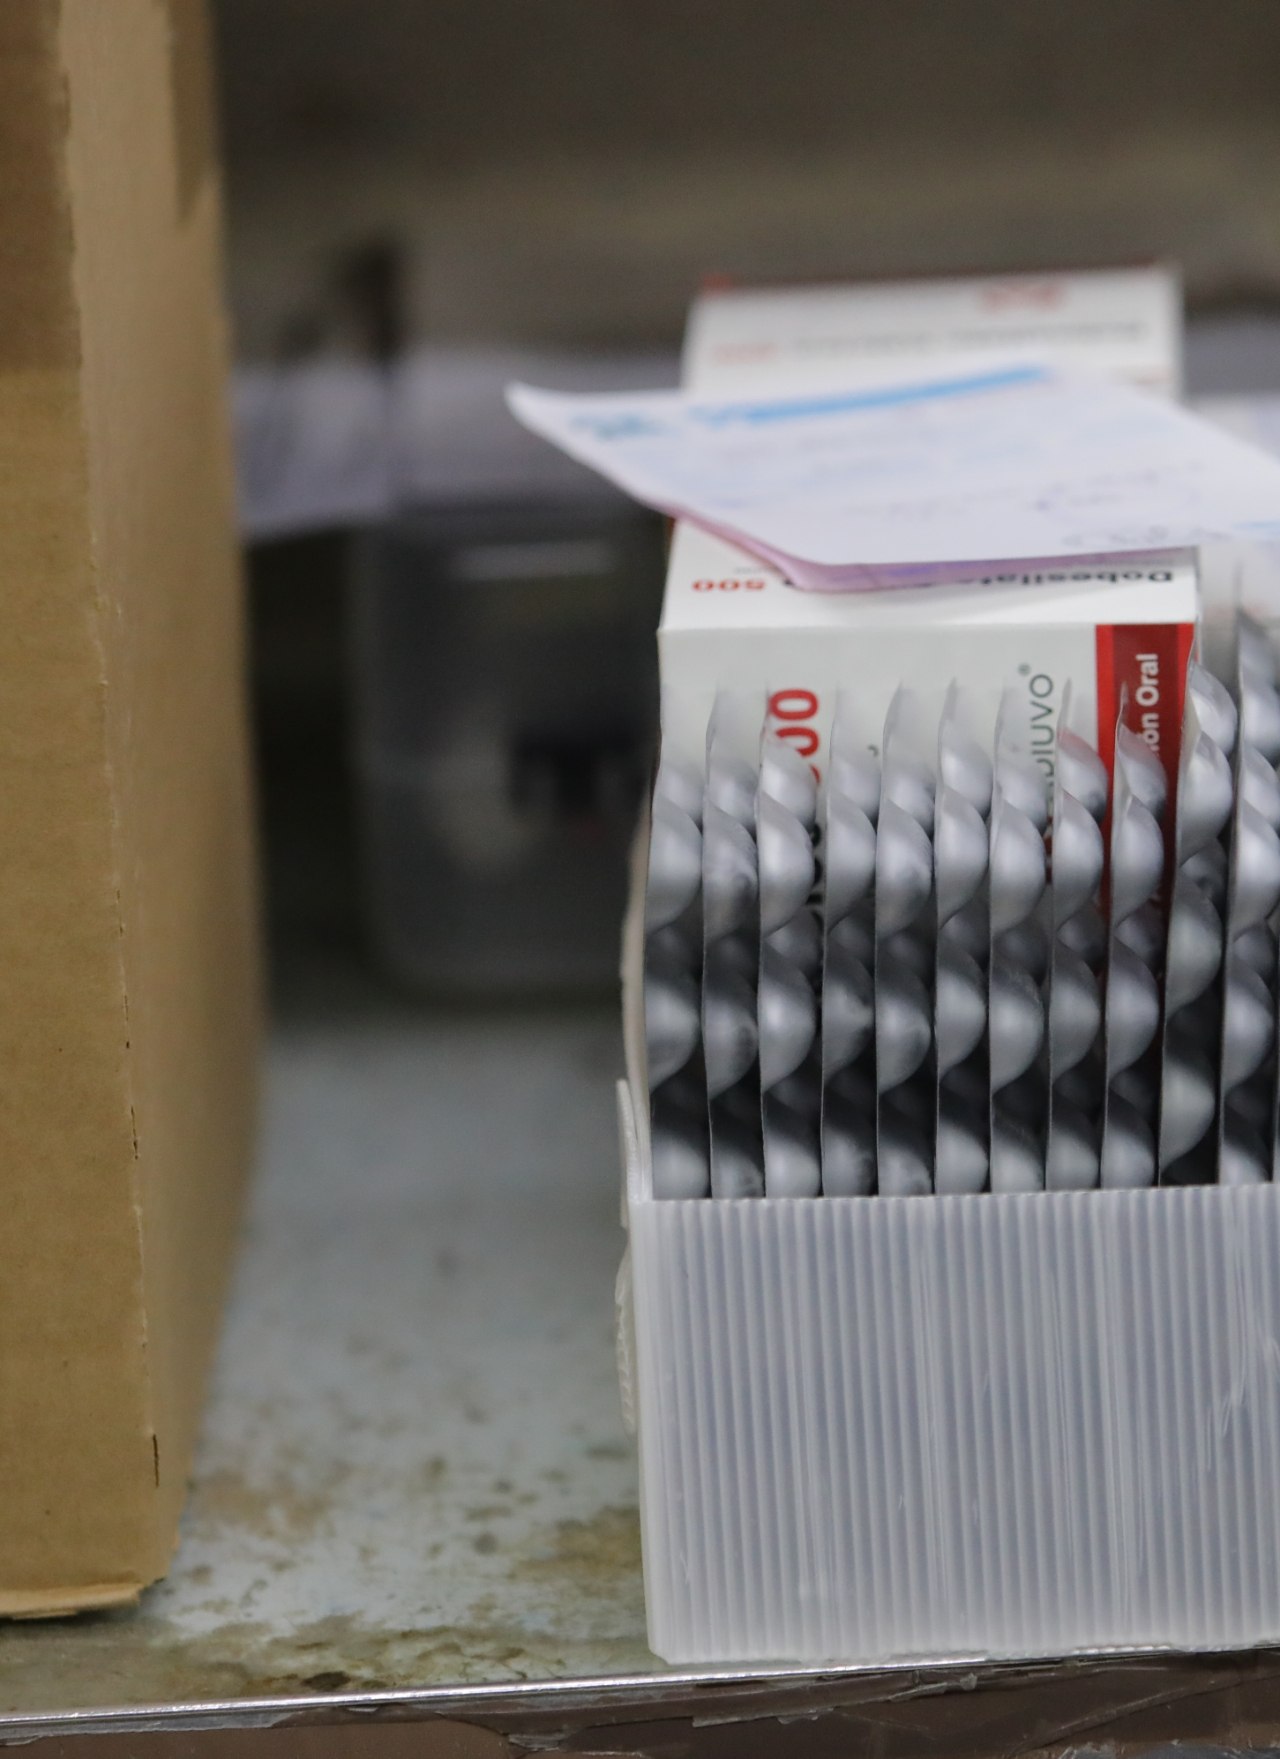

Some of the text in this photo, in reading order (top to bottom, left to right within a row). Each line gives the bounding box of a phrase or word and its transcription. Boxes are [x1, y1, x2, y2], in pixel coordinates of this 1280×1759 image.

[692, 579, 767, 592] 500
[958, 571, 1173, 587] Dobesilat
[1134, 653, 1160, 707] Oral
[768, 688, 820, 785] 00
